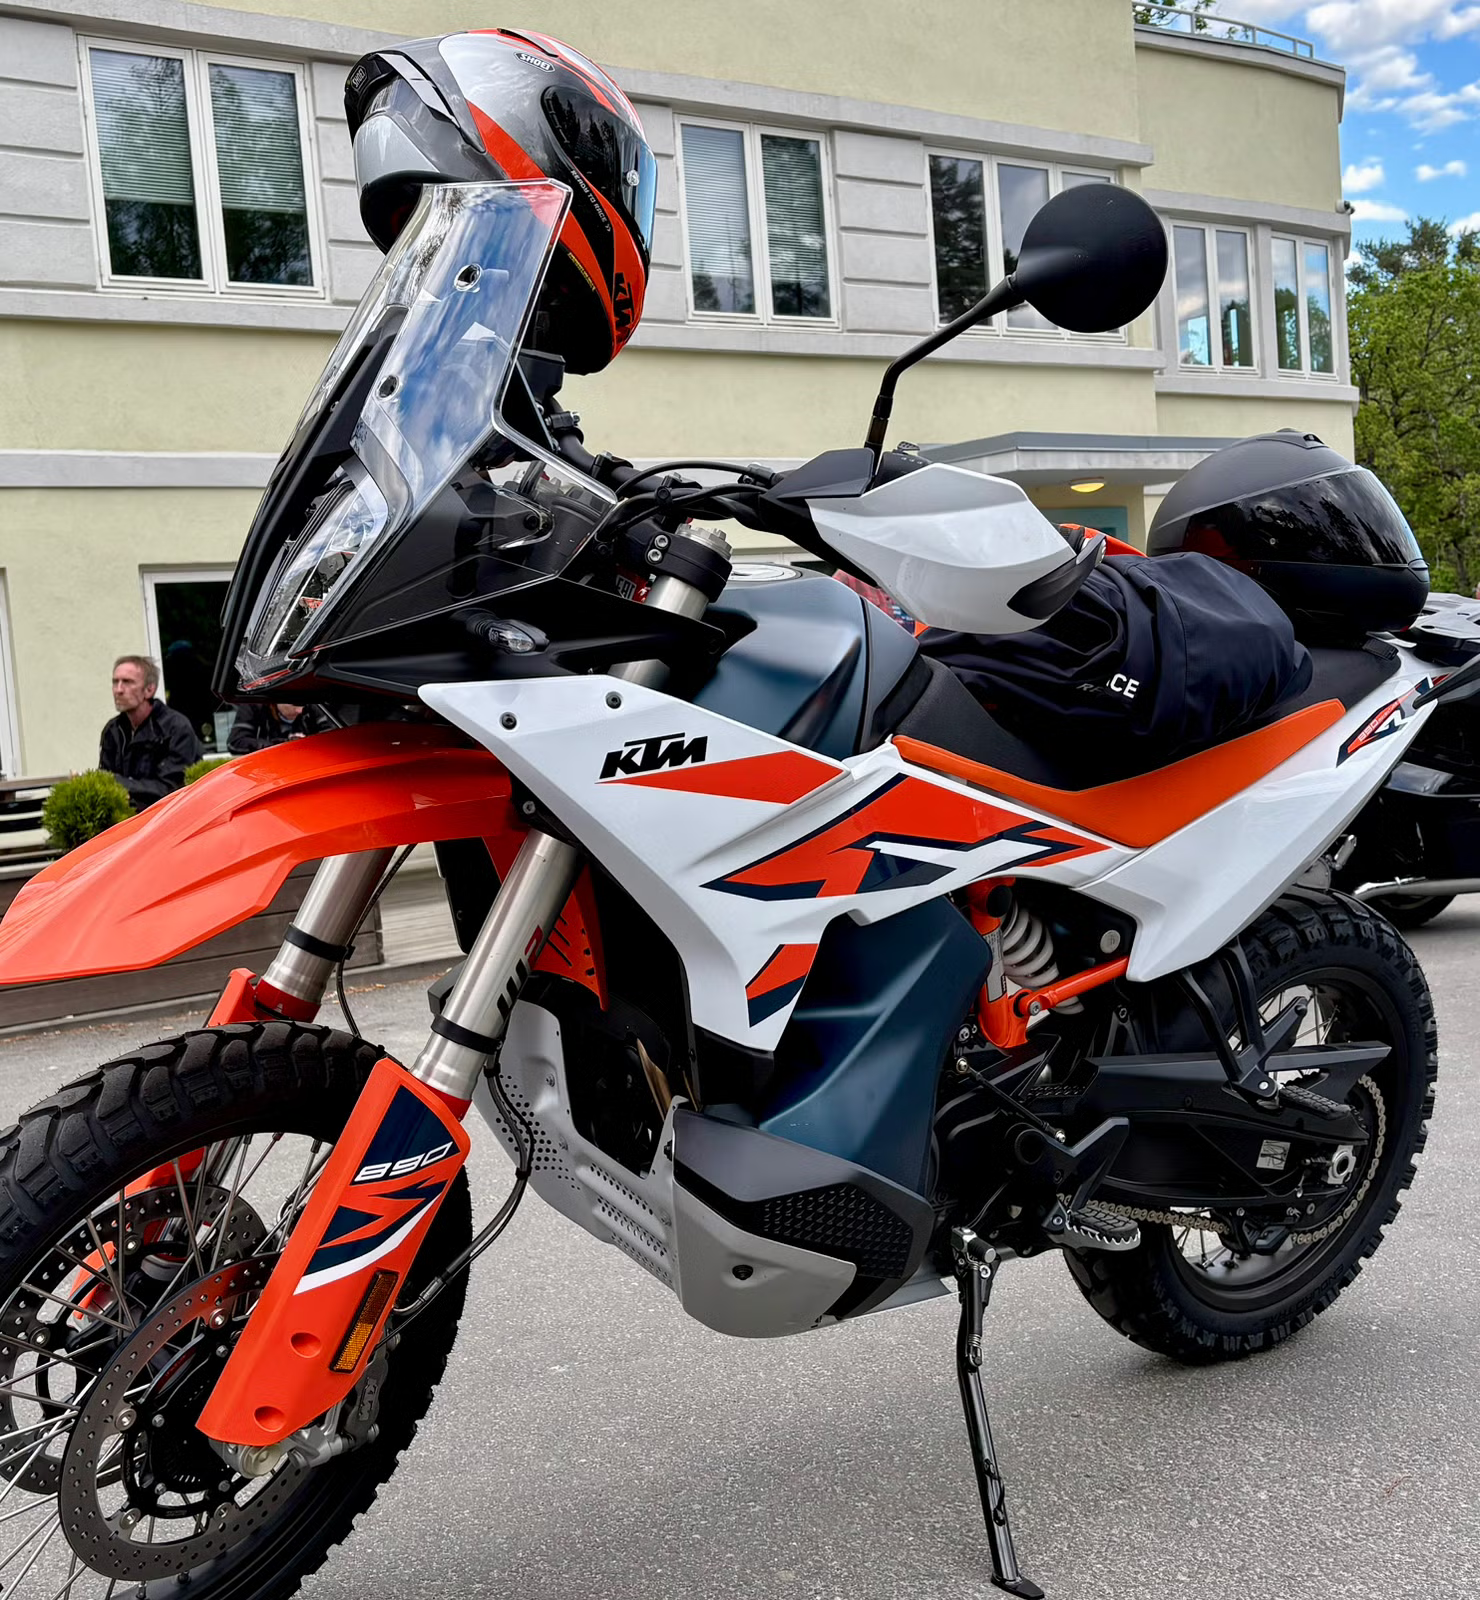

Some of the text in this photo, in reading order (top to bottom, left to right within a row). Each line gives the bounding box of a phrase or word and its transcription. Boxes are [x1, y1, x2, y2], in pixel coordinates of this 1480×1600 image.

[520, 53, 551, 71] SHOEI
[570, 169, 608, 222] READY TO RACE
[614, 272, 635, 344] KTM
[599, 732, 708, 780] KTM
[353, 1141, 454, 1182] 890
